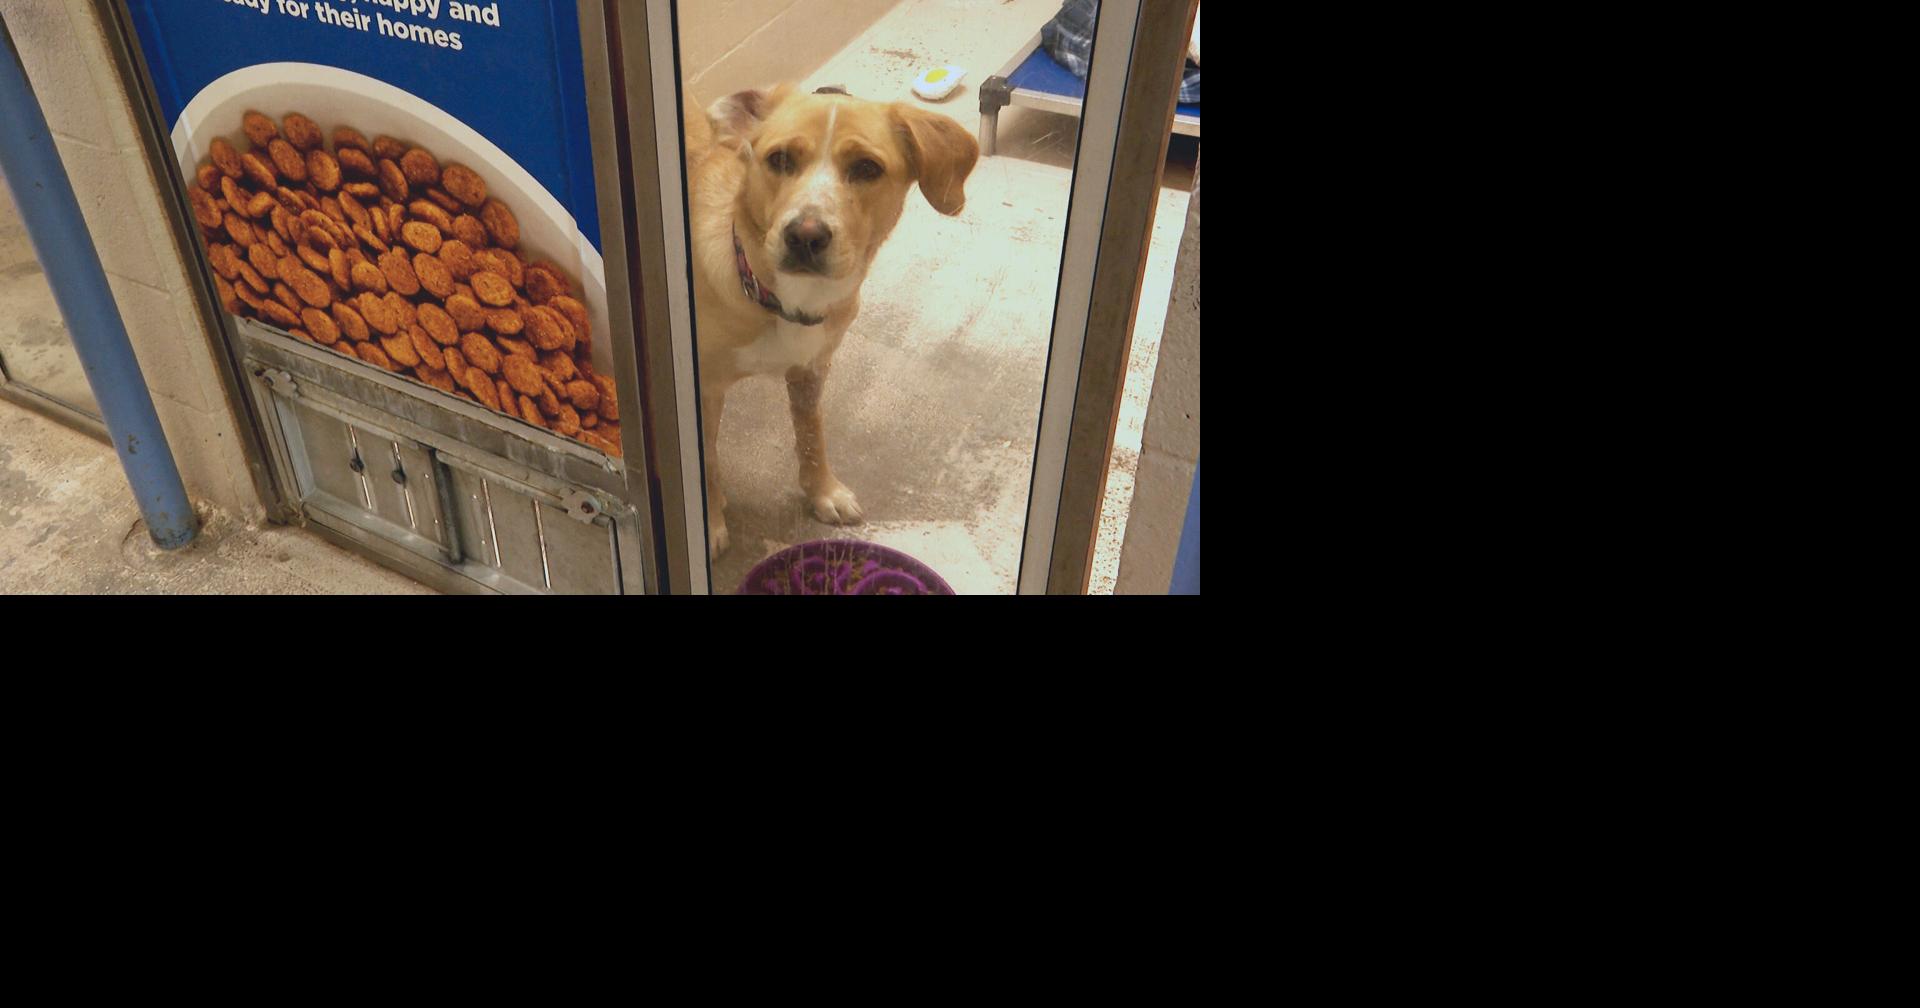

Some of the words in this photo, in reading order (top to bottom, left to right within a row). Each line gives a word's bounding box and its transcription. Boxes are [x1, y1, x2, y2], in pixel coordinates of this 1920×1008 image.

[275, 0, 310, 19] for
[314, 2, 371, 32] their
[376, 13, 463, 51] homes
[449, 1, 501, 27] and
